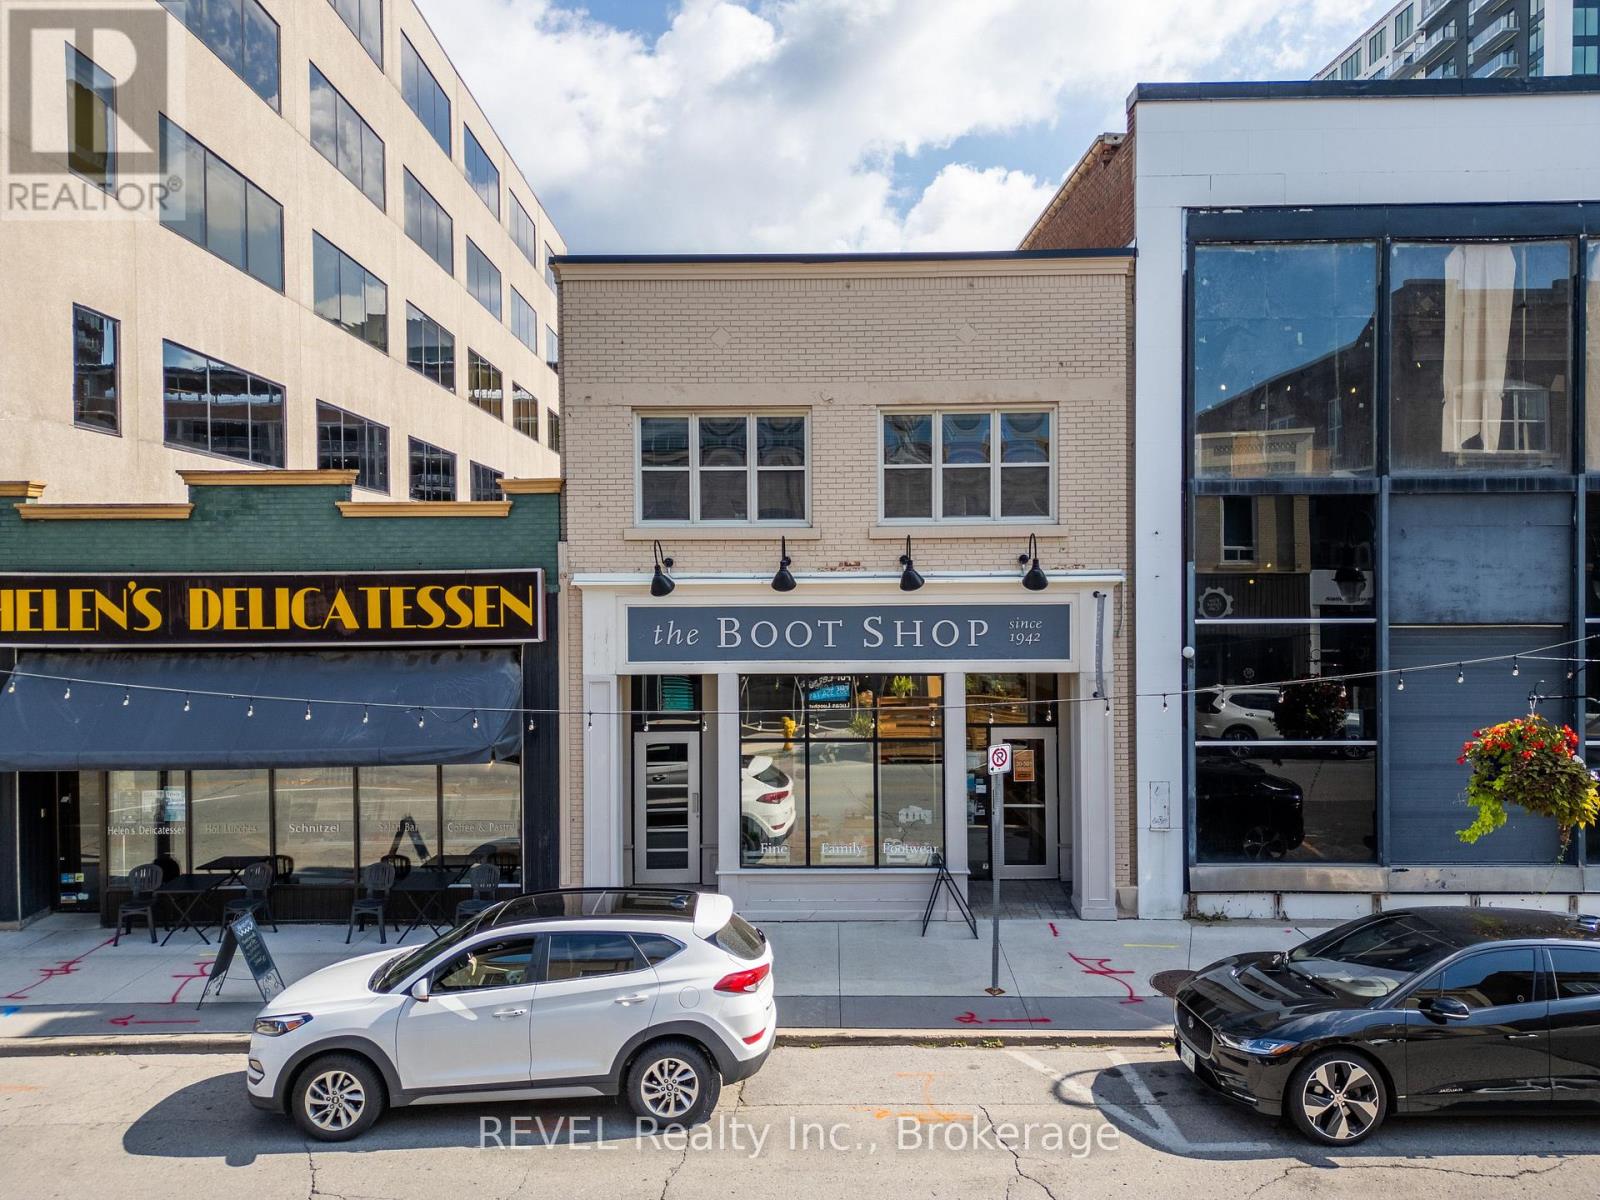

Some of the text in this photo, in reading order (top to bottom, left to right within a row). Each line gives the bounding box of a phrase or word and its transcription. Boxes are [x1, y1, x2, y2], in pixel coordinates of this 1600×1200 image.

[189, 584, 533, 631] DELICATESSEN
[1008, 616, 1043, 629] since
[653, 615, 989, 648] the BOOT SHOP
[1008, 632, 1042, 646] 1942
[288, 823, 340, 833] Schnitzel
[760, 842, 939, 857] Fine Family Footwear
